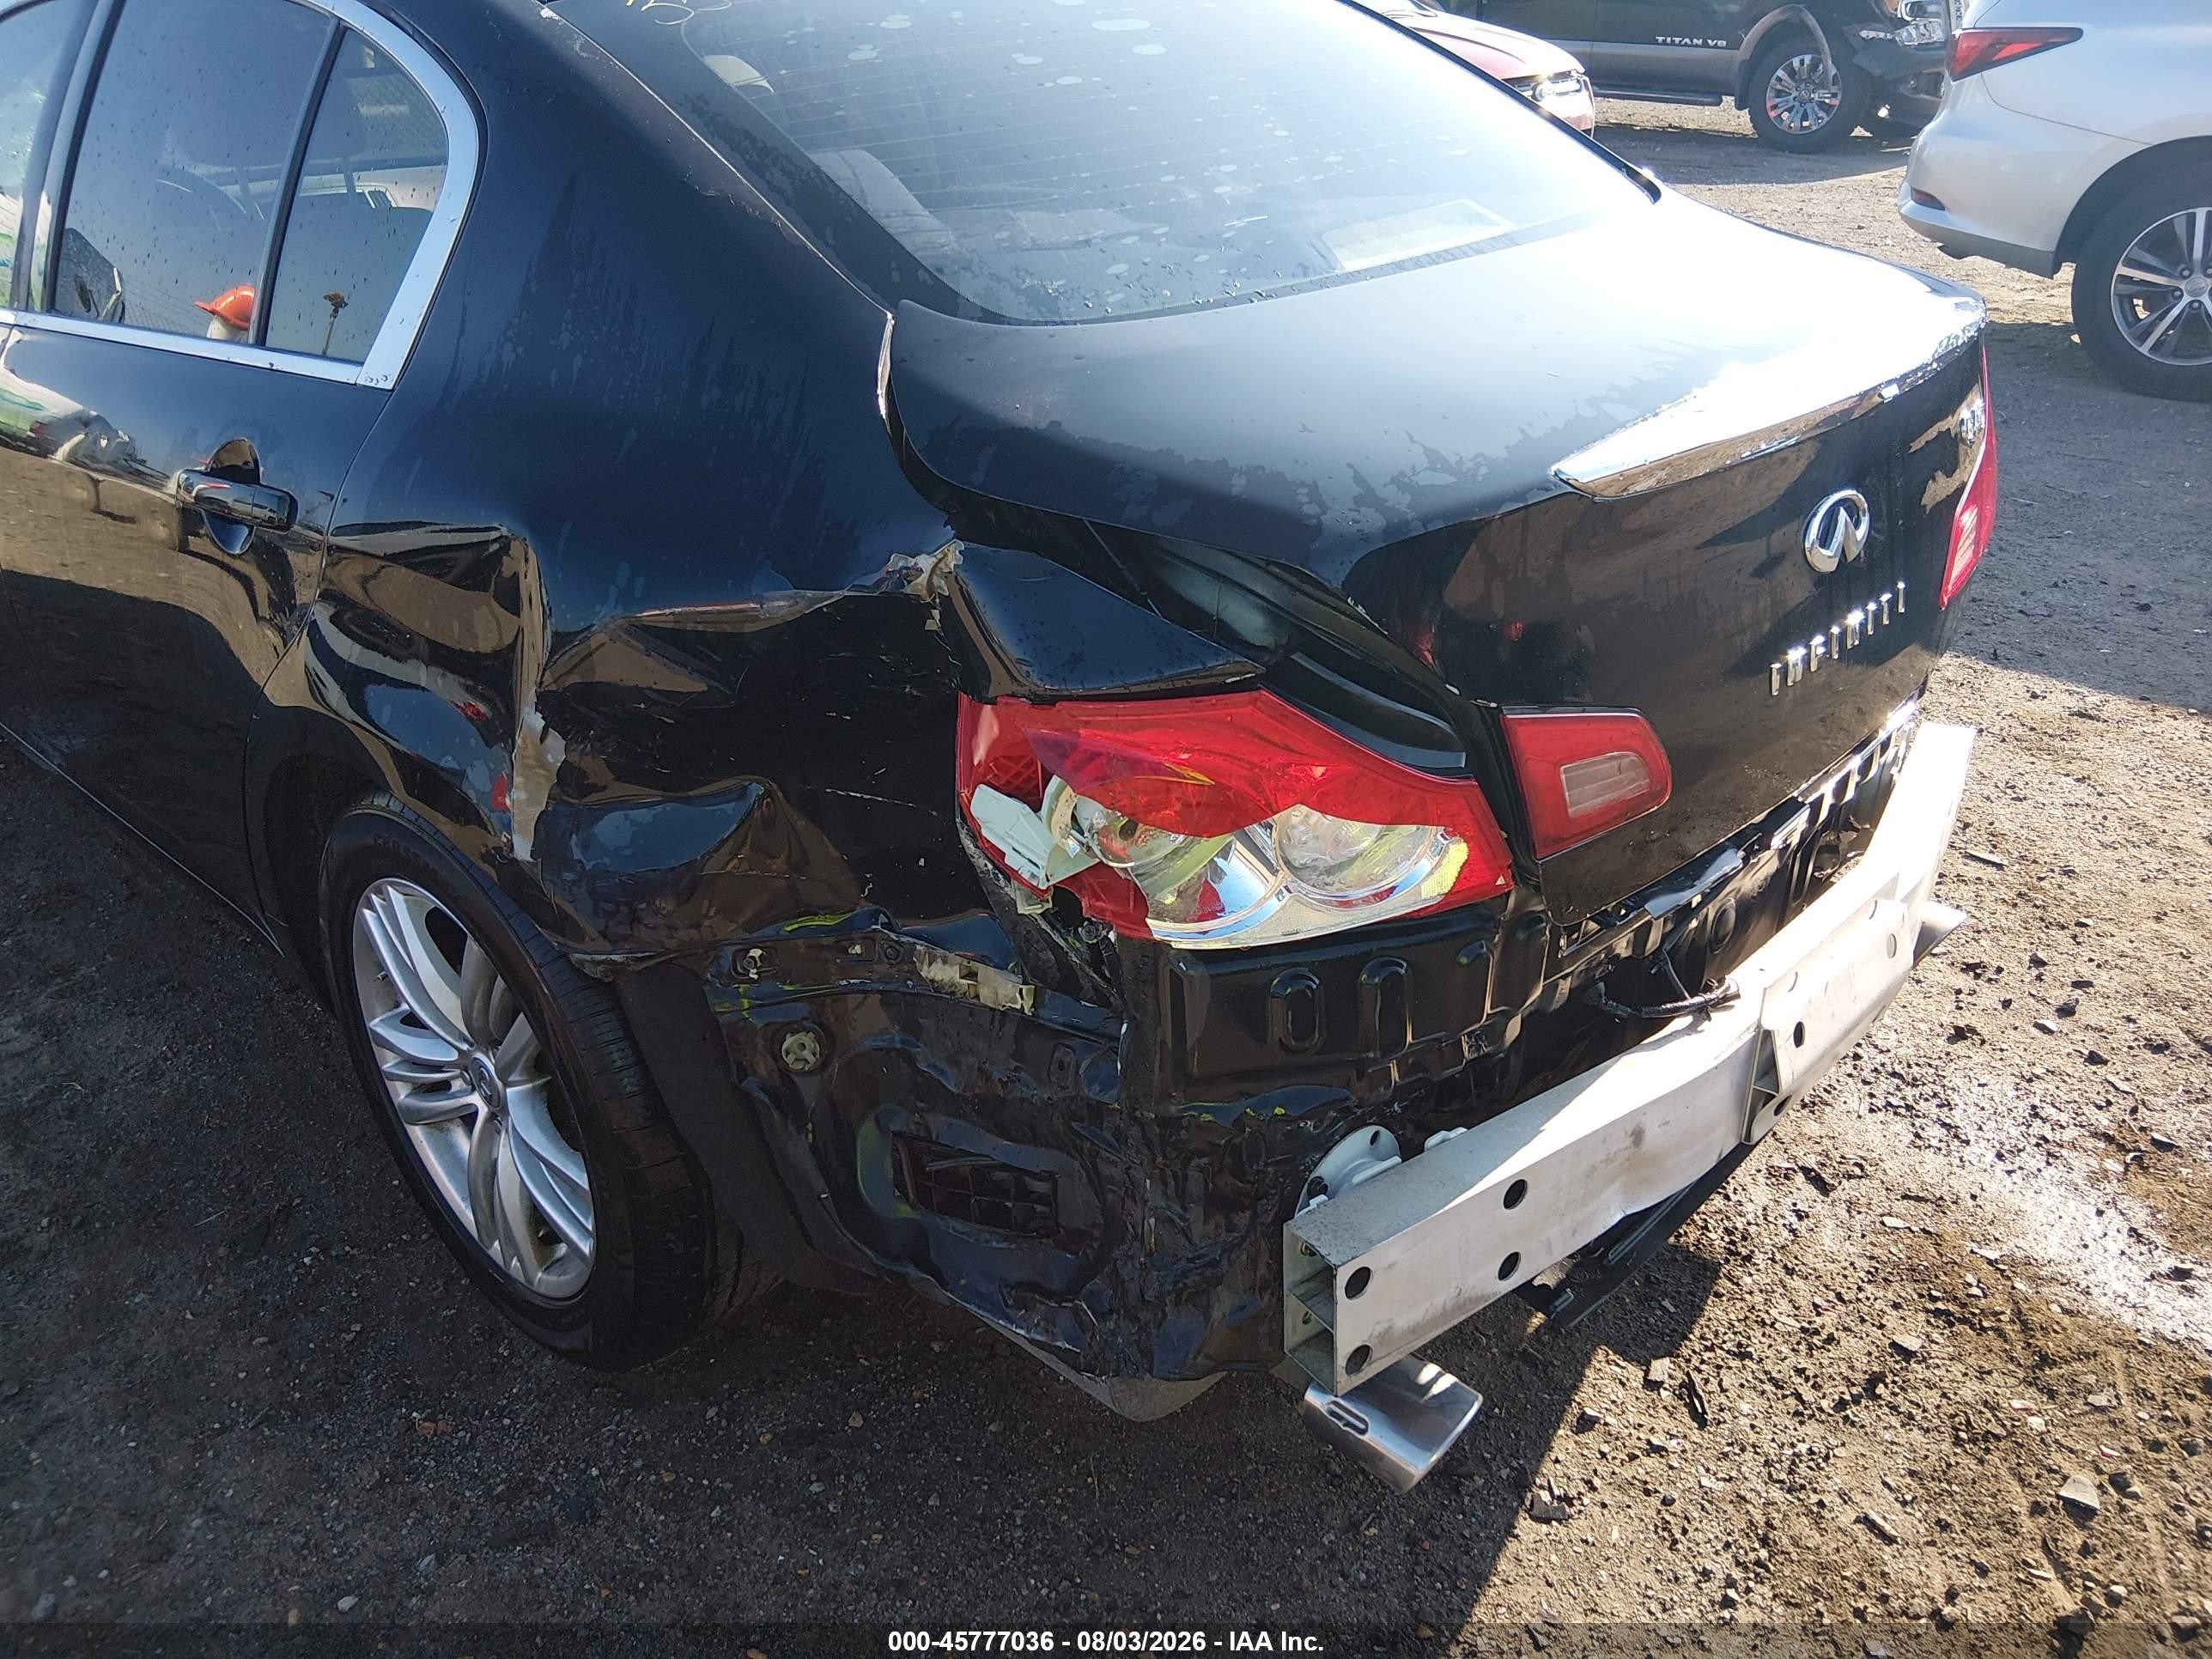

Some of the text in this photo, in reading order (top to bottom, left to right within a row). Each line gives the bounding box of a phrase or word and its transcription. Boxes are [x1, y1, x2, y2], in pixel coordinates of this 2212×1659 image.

[1655, 36, 1727, 47] TITAN V8
[1770, 580, 1906, 696] INFINITI
